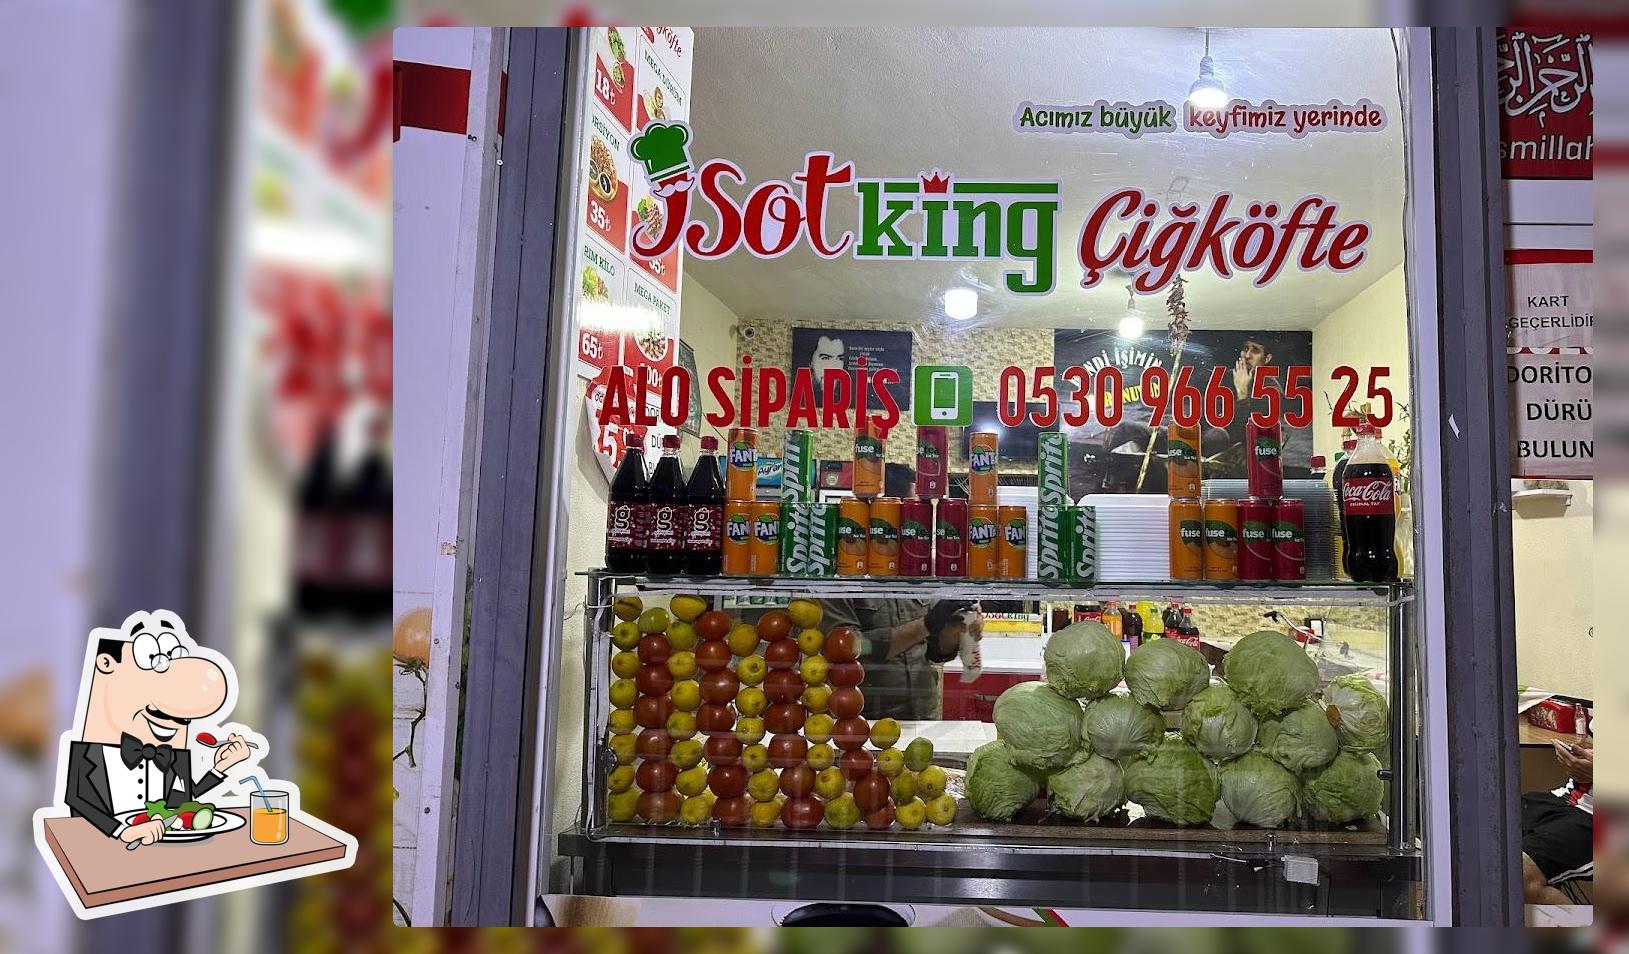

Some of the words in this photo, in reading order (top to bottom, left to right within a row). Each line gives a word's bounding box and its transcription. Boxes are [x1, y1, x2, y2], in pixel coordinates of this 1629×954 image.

[1020, 105, 1092, 128] Acımız
[1099, 105, 1172, 133] büyük
[1189, 104, 1286, 133] keyfimiz
[1294, 105, 1382, 133] yerinde
[856, 178, 1060, 293] king
[1080, 190, 1369, 293] Çiğköfte
[634, 282, 652, 302] MEGA
[652, 296, 671, 315] PAKET
[1527, 295, 1570, 308] KART
[600, 366, 690, 427] ALO
[706, 354, 901, 439] SİPARİŞ
[999, 365, 1123, 428] 0530
[1141, 365, 1236, 428] 966
[1251, 365, 1313, 428] 55
[1331, 365, 1393, 428] 25
[1526, 399, 1592, 421] DÜRÜ
[1254, 445, 1277, 456] fuse
[1517, 440, 1593, 458] BULUN
[1180, 527, 1201, 538] fuse
[1243, 528, 1265, 539] fuse
